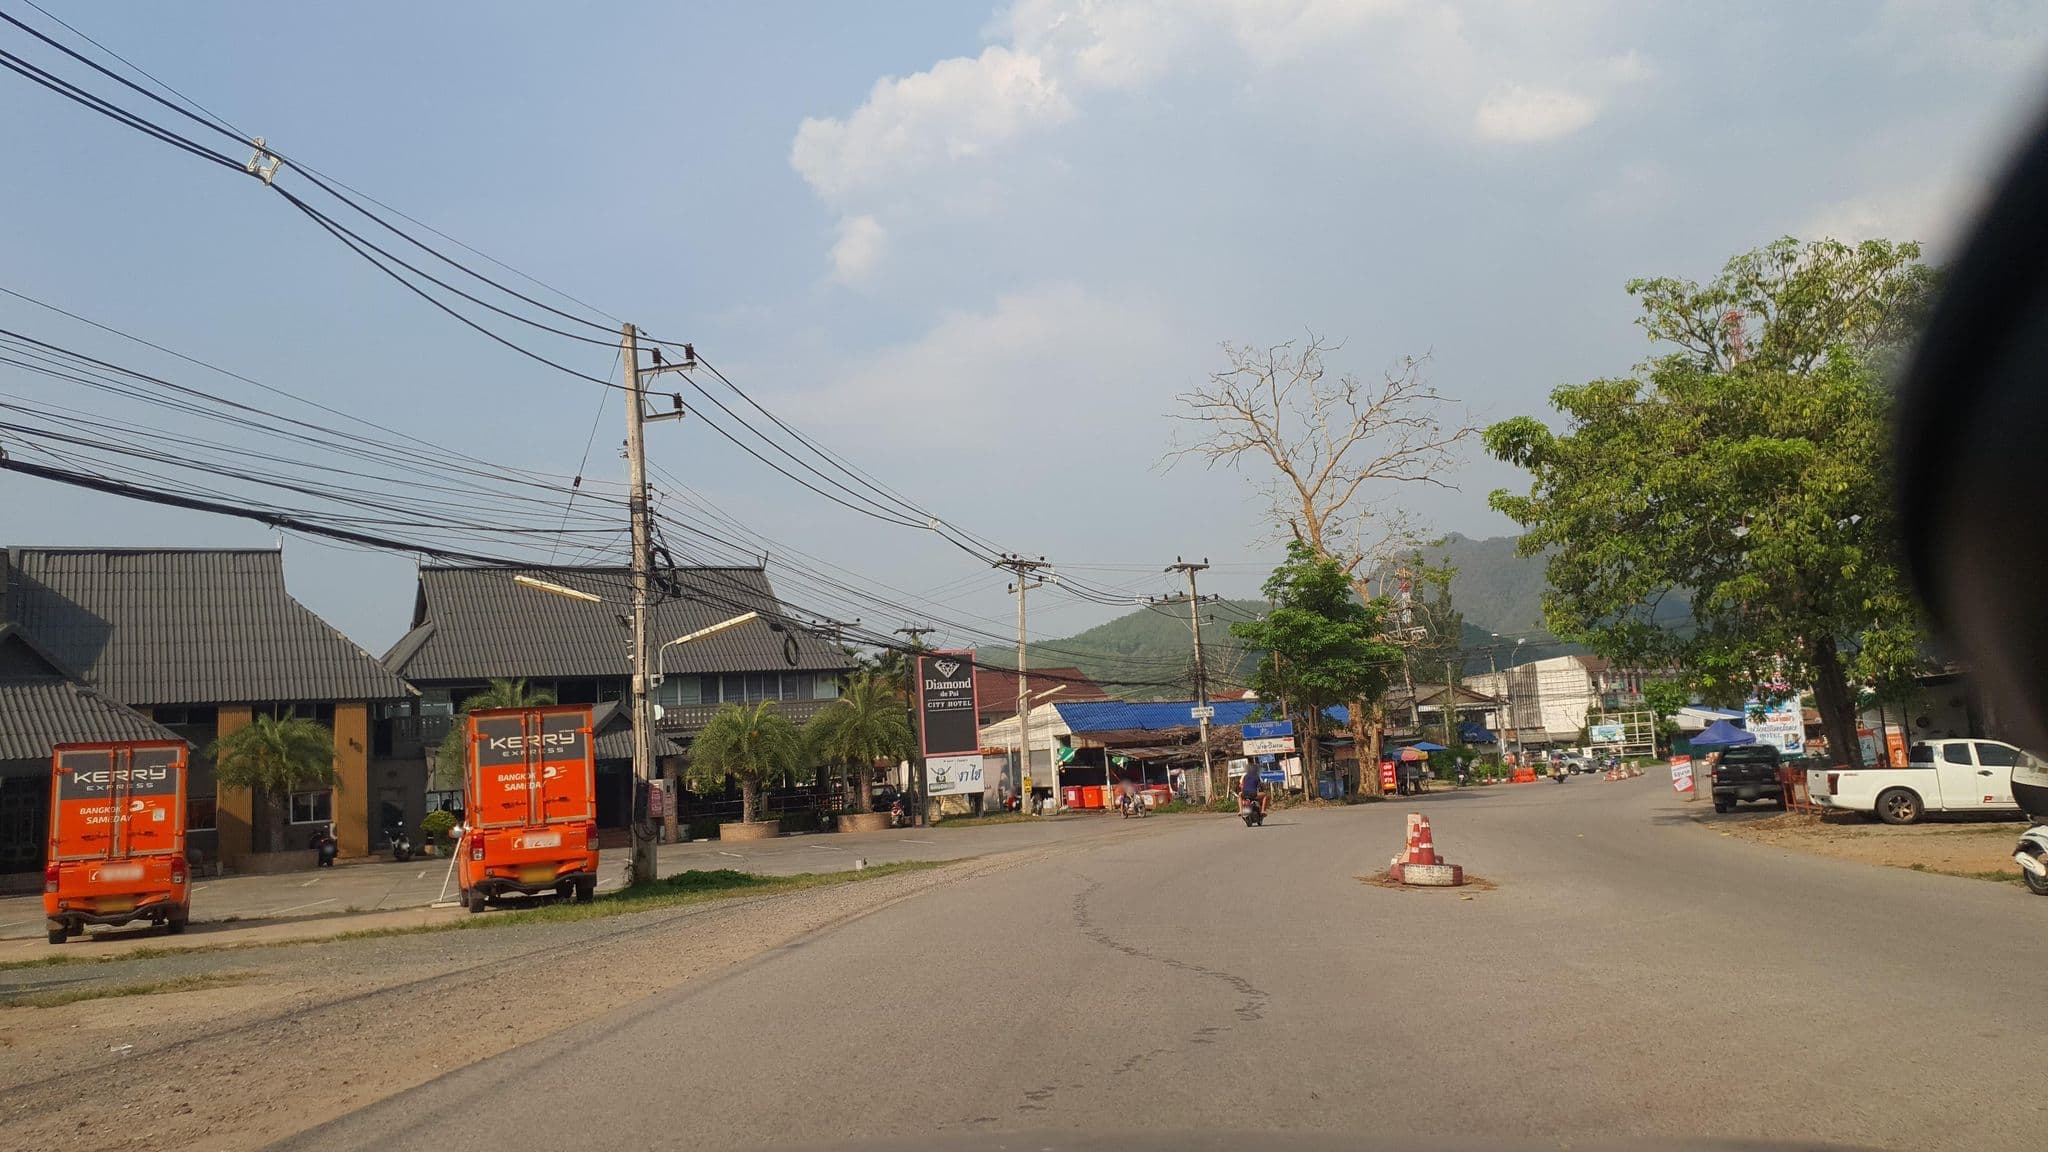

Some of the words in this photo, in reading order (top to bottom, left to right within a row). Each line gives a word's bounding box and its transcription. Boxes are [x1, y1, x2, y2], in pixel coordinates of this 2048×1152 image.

[926, 678, 972, 690] Diamond
[948, 700, 972, 708] HOTEL
[490, 732, 575, 750] KERRY
[73, 768, 167, 784] KERRY
[86, 782, 154, 791] EXPRESS
[504, 780, 547, 792] SAMDA
[80, 806, 121, 815] BANGKOK
[86, 815, 132, 824] SAMEDAY
